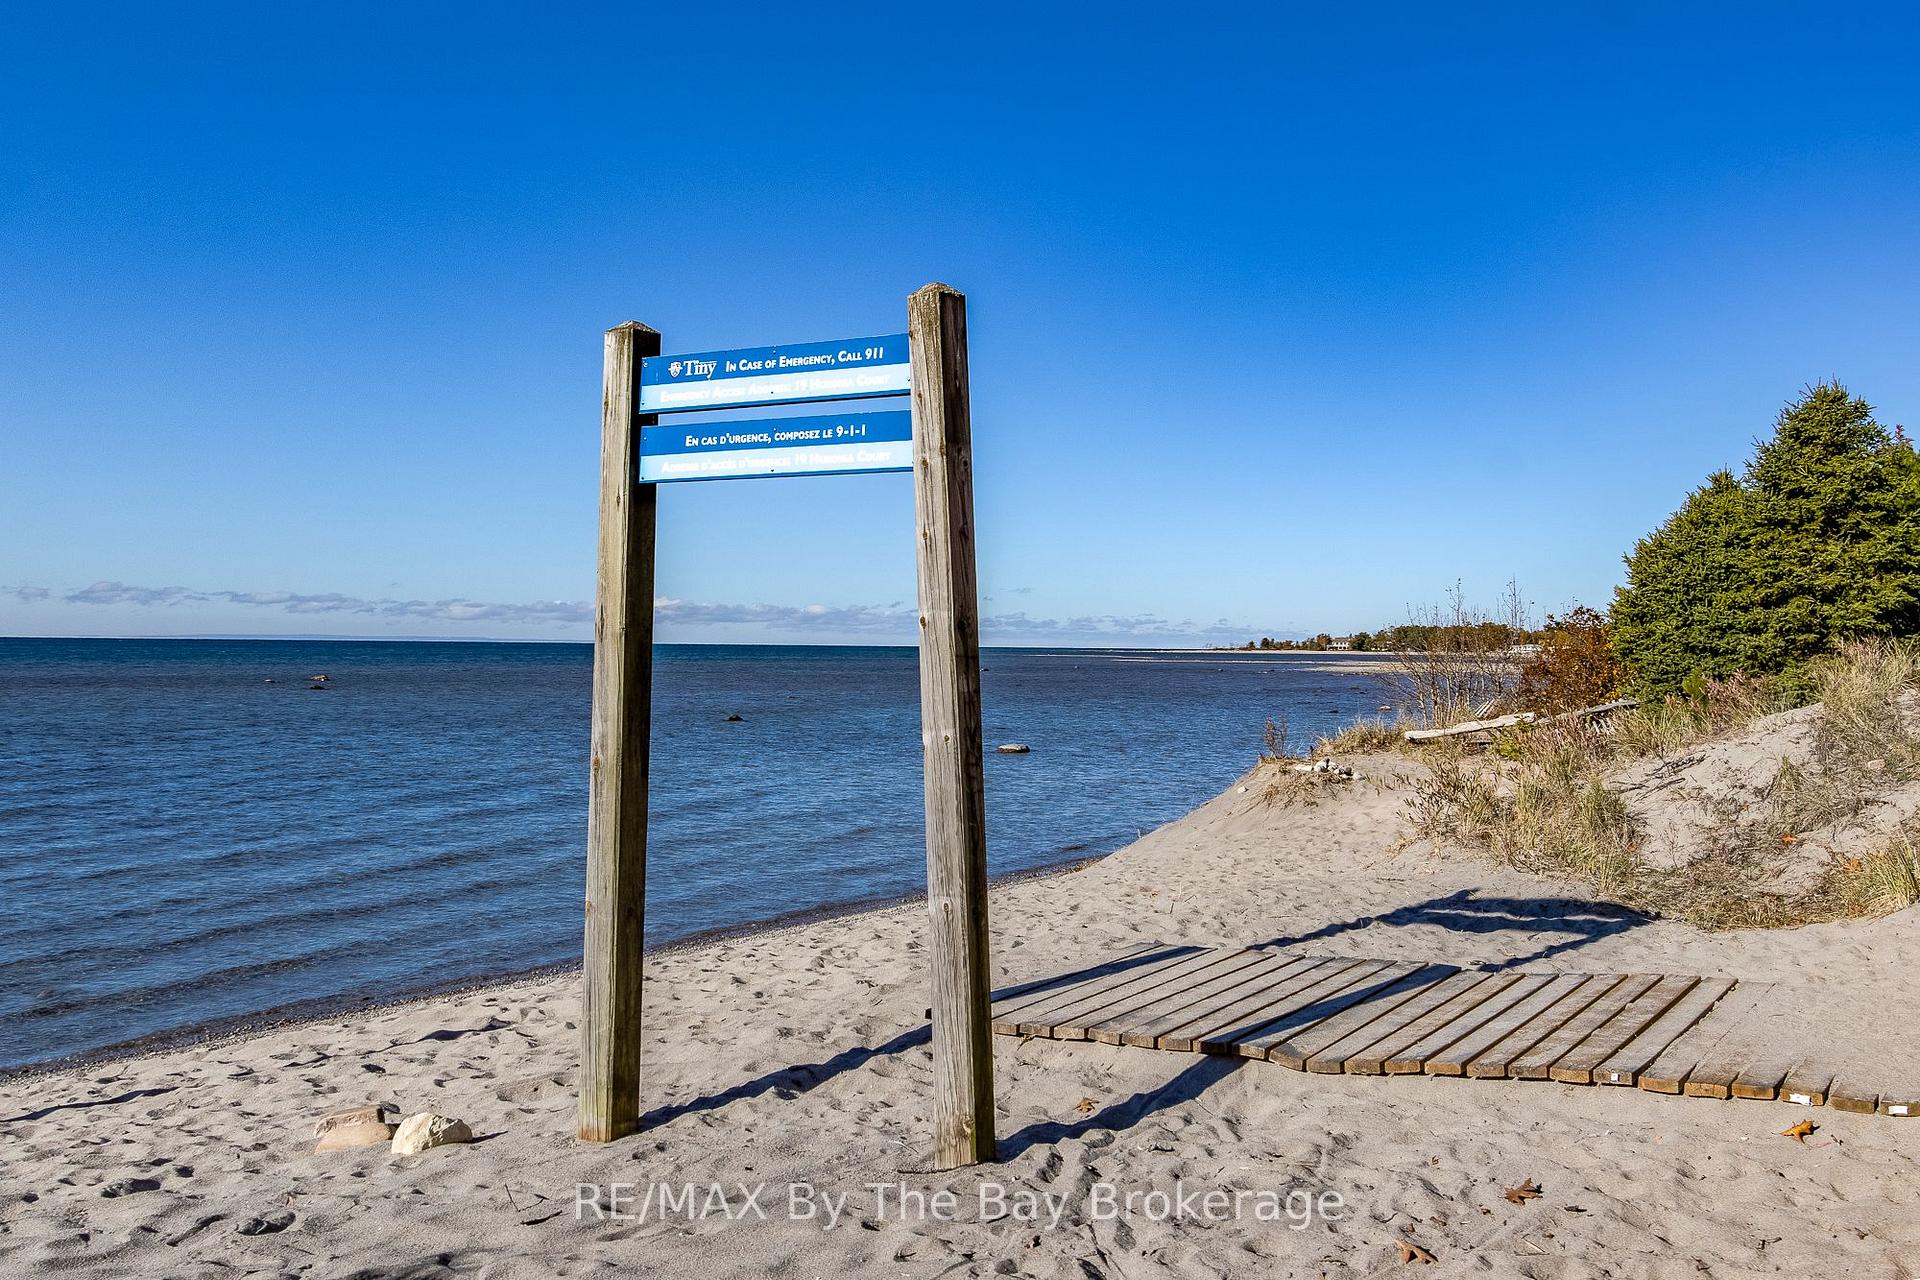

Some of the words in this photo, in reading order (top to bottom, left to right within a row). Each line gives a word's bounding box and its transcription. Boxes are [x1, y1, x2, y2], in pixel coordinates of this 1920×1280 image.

[683, 360, 717, 380] Tiny
[725, 360, 738, 372] IN
[739, 359, 763, 371] CASE
[764, 359, 777, 369] OF
[779, 354, 836, 368] EMERGENCY,
[837, 350, 862, 362] CALL
[864, 346, 884, 360] 911
[685, 435, 699, 447] EN
[701, 436, 717, 446] CAS
[719, 432, 771, 445] D'URGENCE,
[774, 429, 821, 441] COMPOSEZ
[822, 428, 833, 439] LE
[836, 423, 866, 437] 9-1-1
